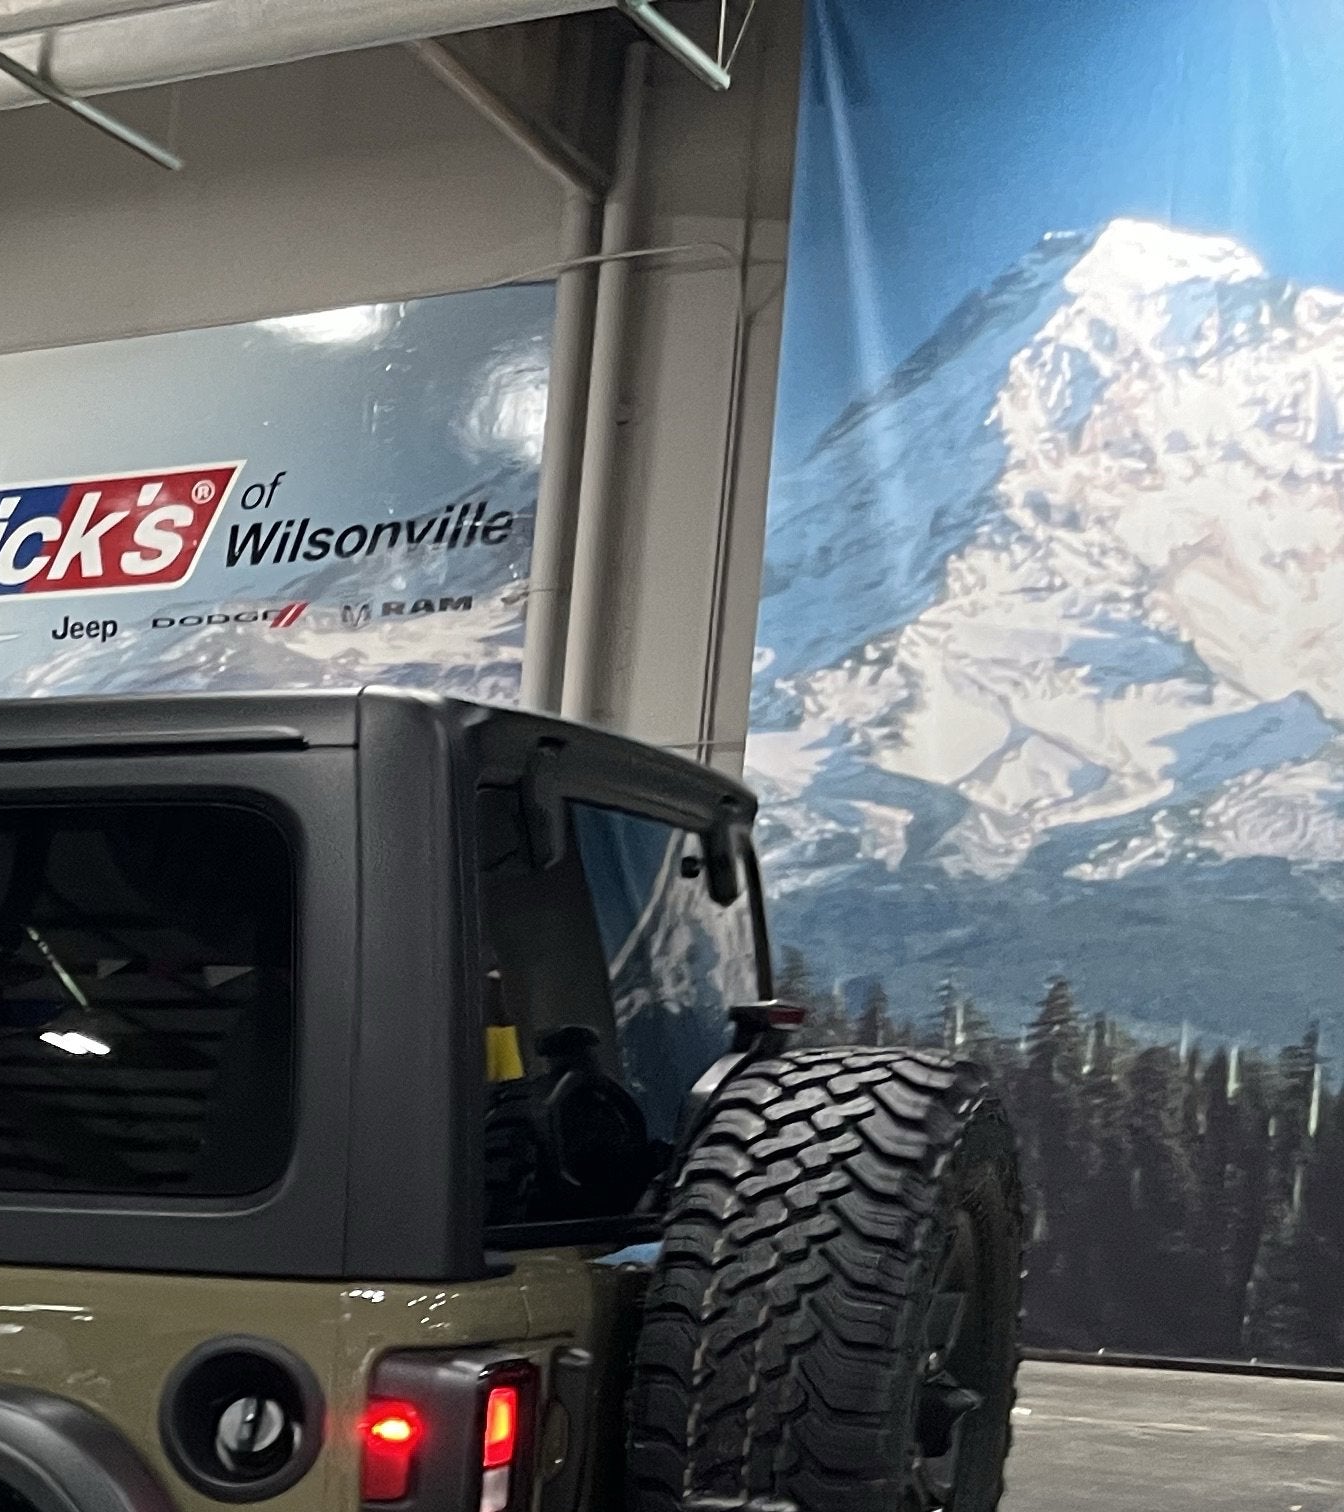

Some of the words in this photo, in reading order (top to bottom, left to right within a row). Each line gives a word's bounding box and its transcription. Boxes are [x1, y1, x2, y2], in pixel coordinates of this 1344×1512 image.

[240, 470, 287, 510] of
[225, 500, 514, 568] Wilsonville
[51, 615, 119, 643] Jeep
[380, 595, 473, 617] RAM
